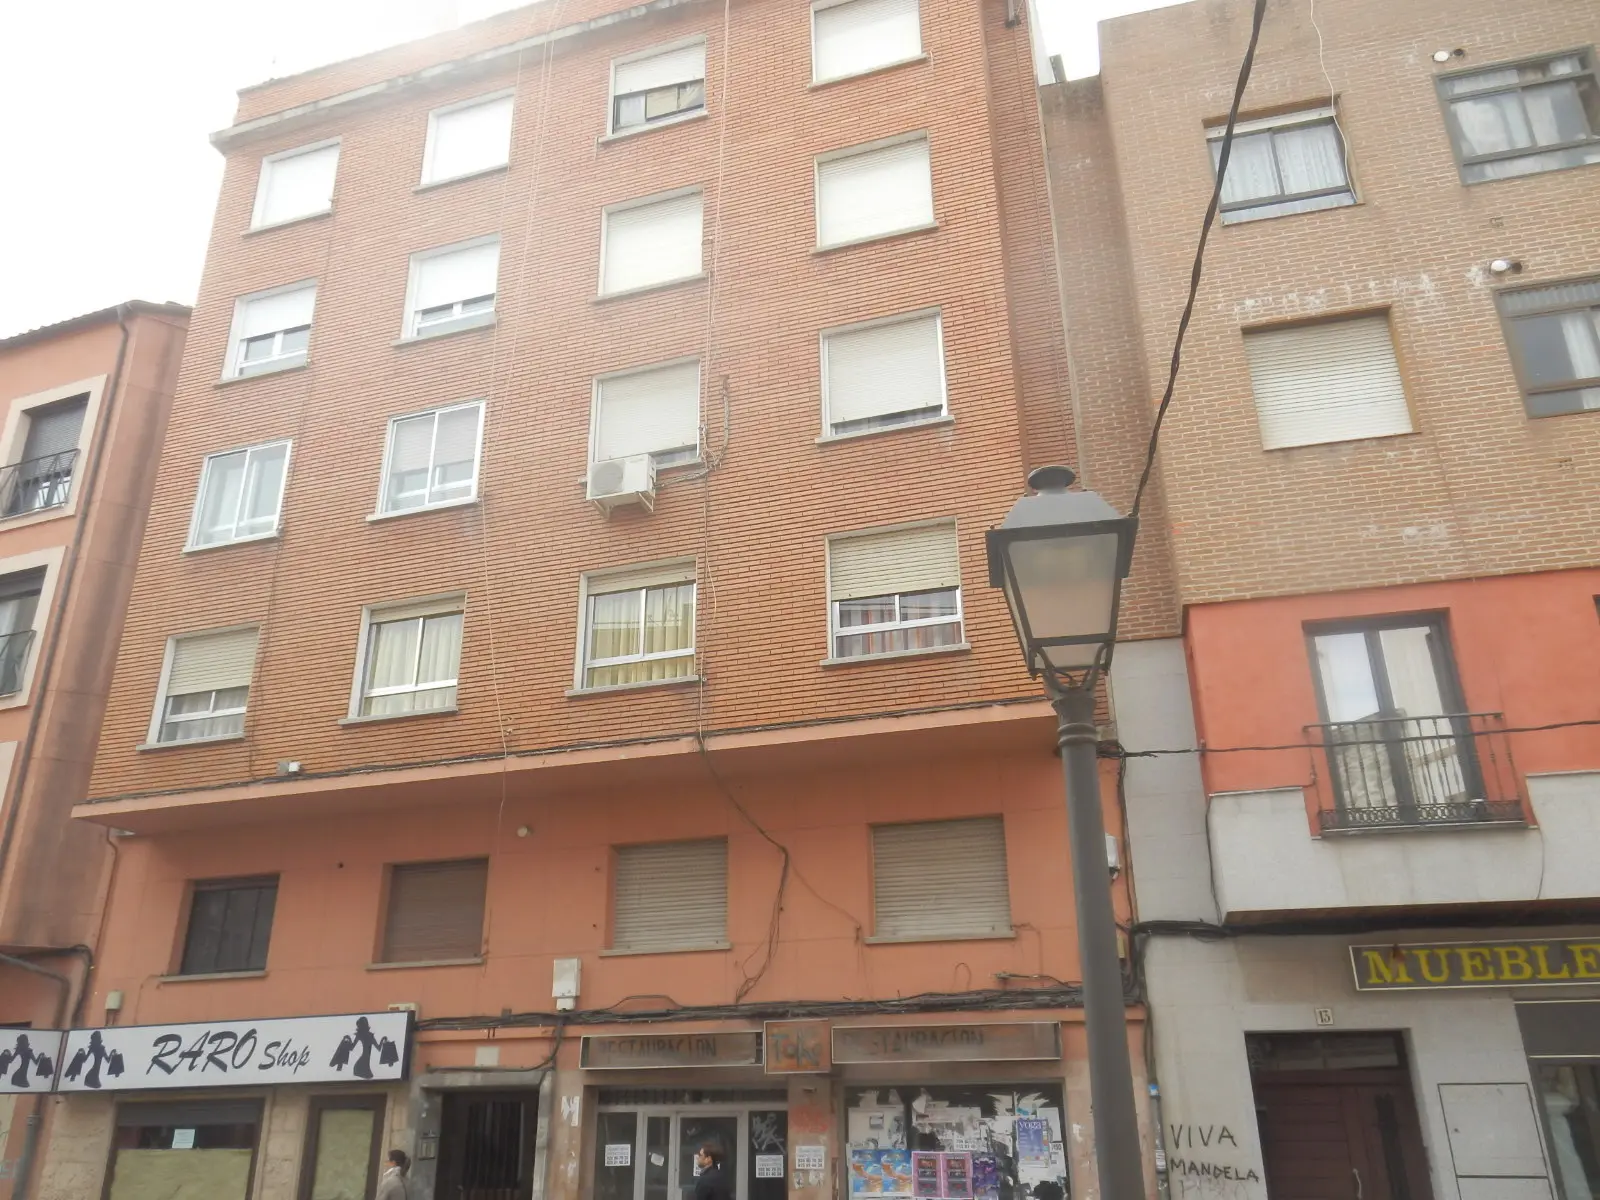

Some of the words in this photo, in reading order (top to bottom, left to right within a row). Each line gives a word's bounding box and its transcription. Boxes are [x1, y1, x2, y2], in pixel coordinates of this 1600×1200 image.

[146, 1028, 257, 1075] RARO
[258, 1038, 311, 1075] Shop
[1170, 1124, 1237, 1150] VIVA
[1170, 1157, 1259, 1183] MANDELA
